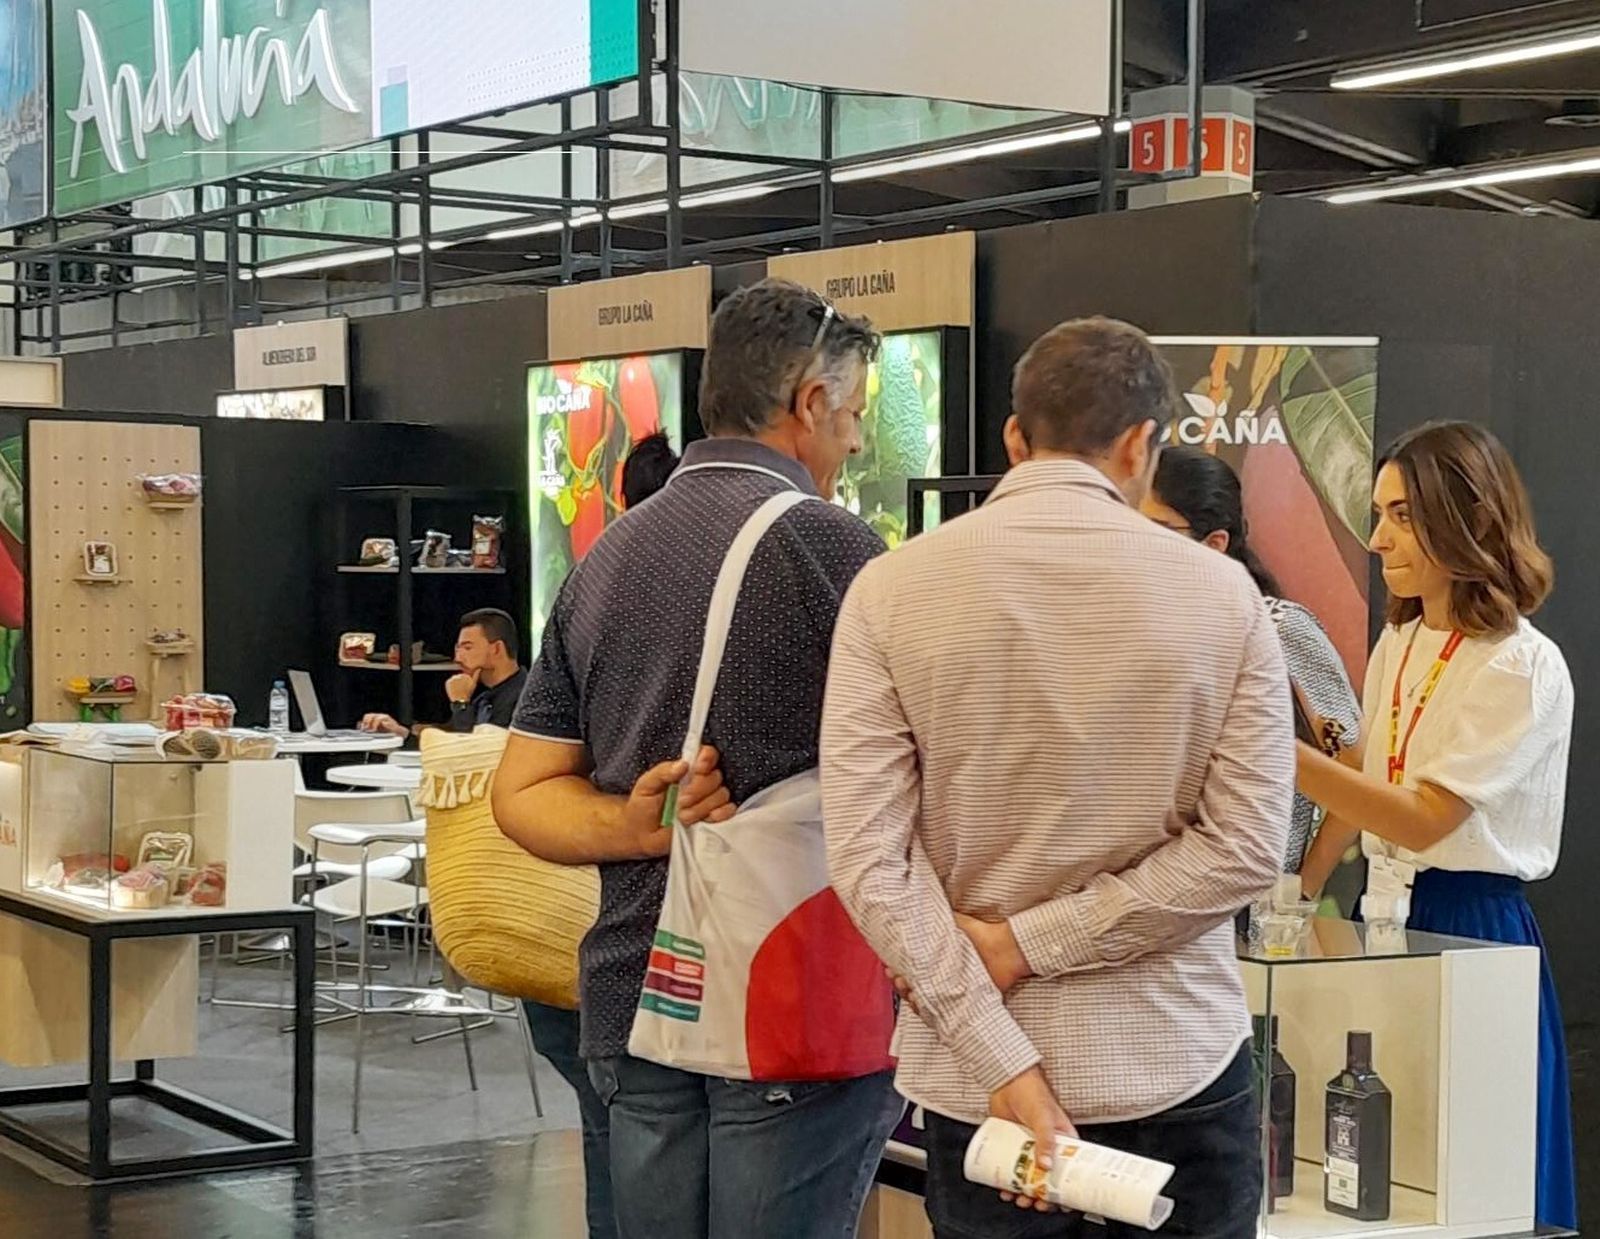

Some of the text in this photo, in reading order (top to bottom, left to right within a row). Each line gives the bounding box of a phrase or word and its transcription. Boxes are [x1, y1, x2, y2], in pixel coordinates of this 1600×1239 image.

[1143, 131, 1155, 165] 5
[1238, 132, 1246, 165] 5
[857, 275, 869, 297] LA
